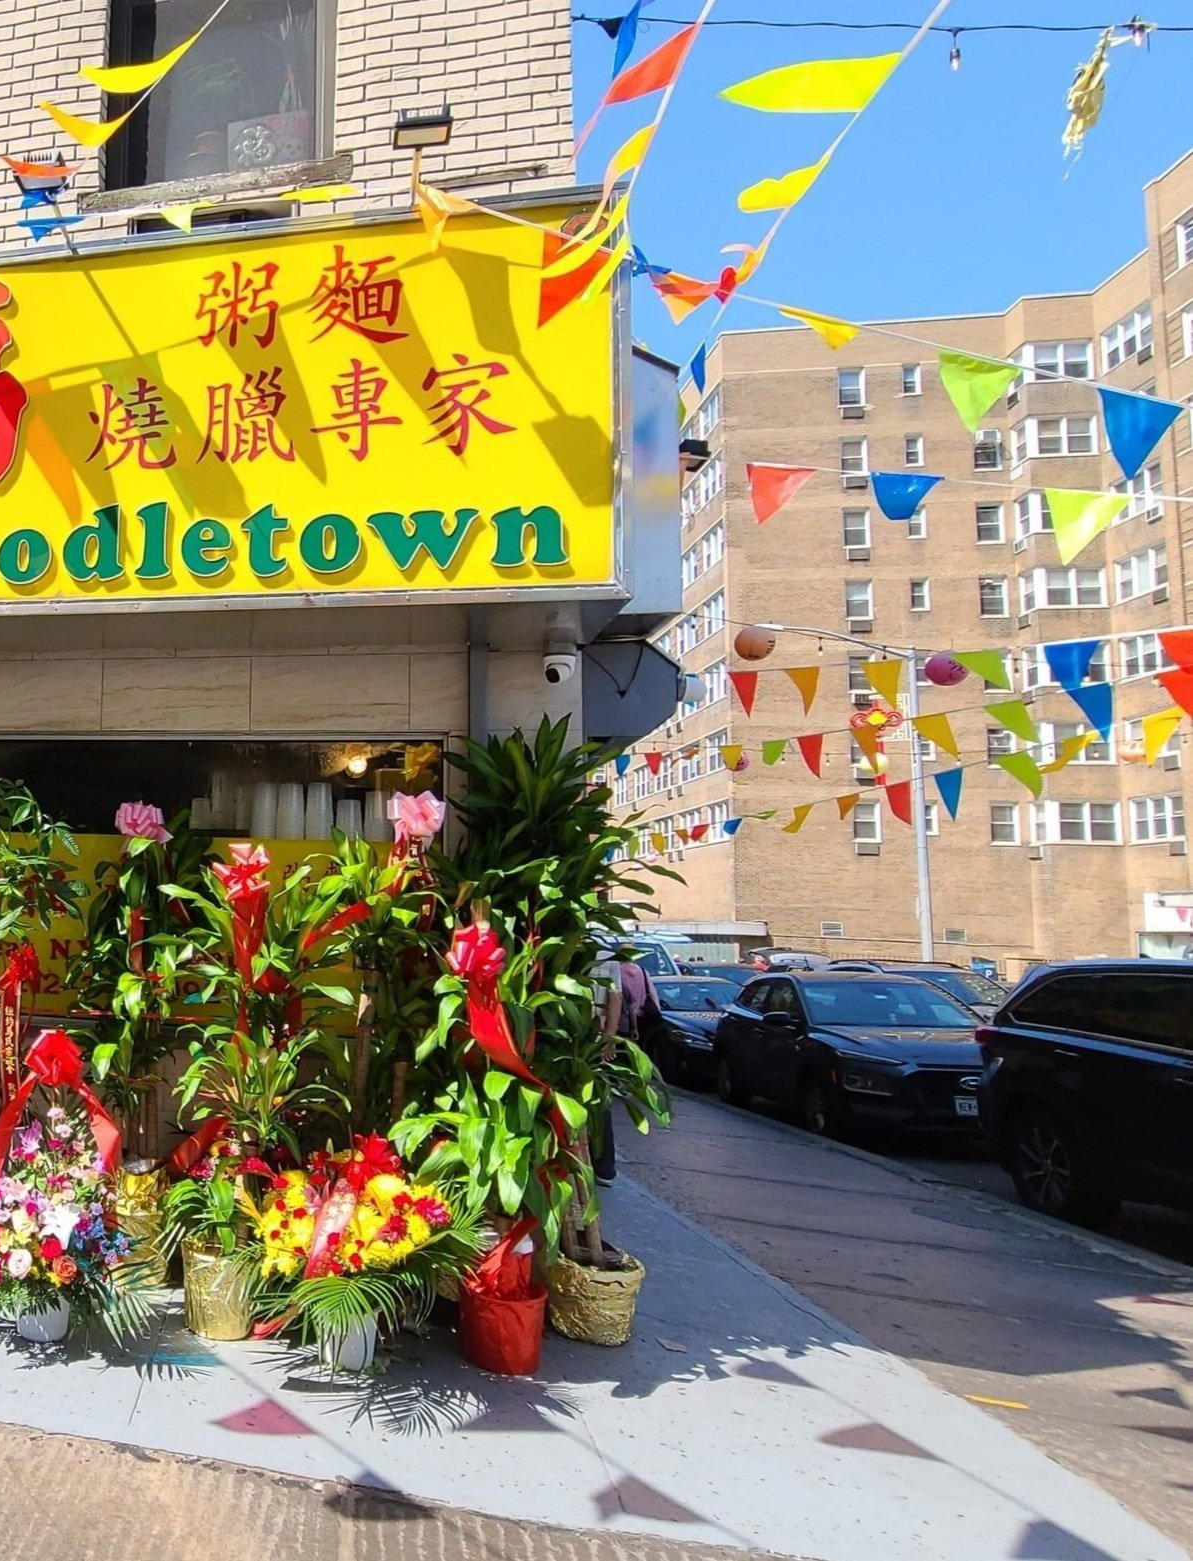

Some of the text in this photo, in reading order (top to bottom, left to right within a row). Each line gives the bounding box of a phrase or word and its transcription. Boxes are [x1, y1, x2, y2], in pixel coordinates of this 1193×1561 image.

[196, 244, 409, 348] 粥麵
[86, 353, 518, 471] 燒臘專家
